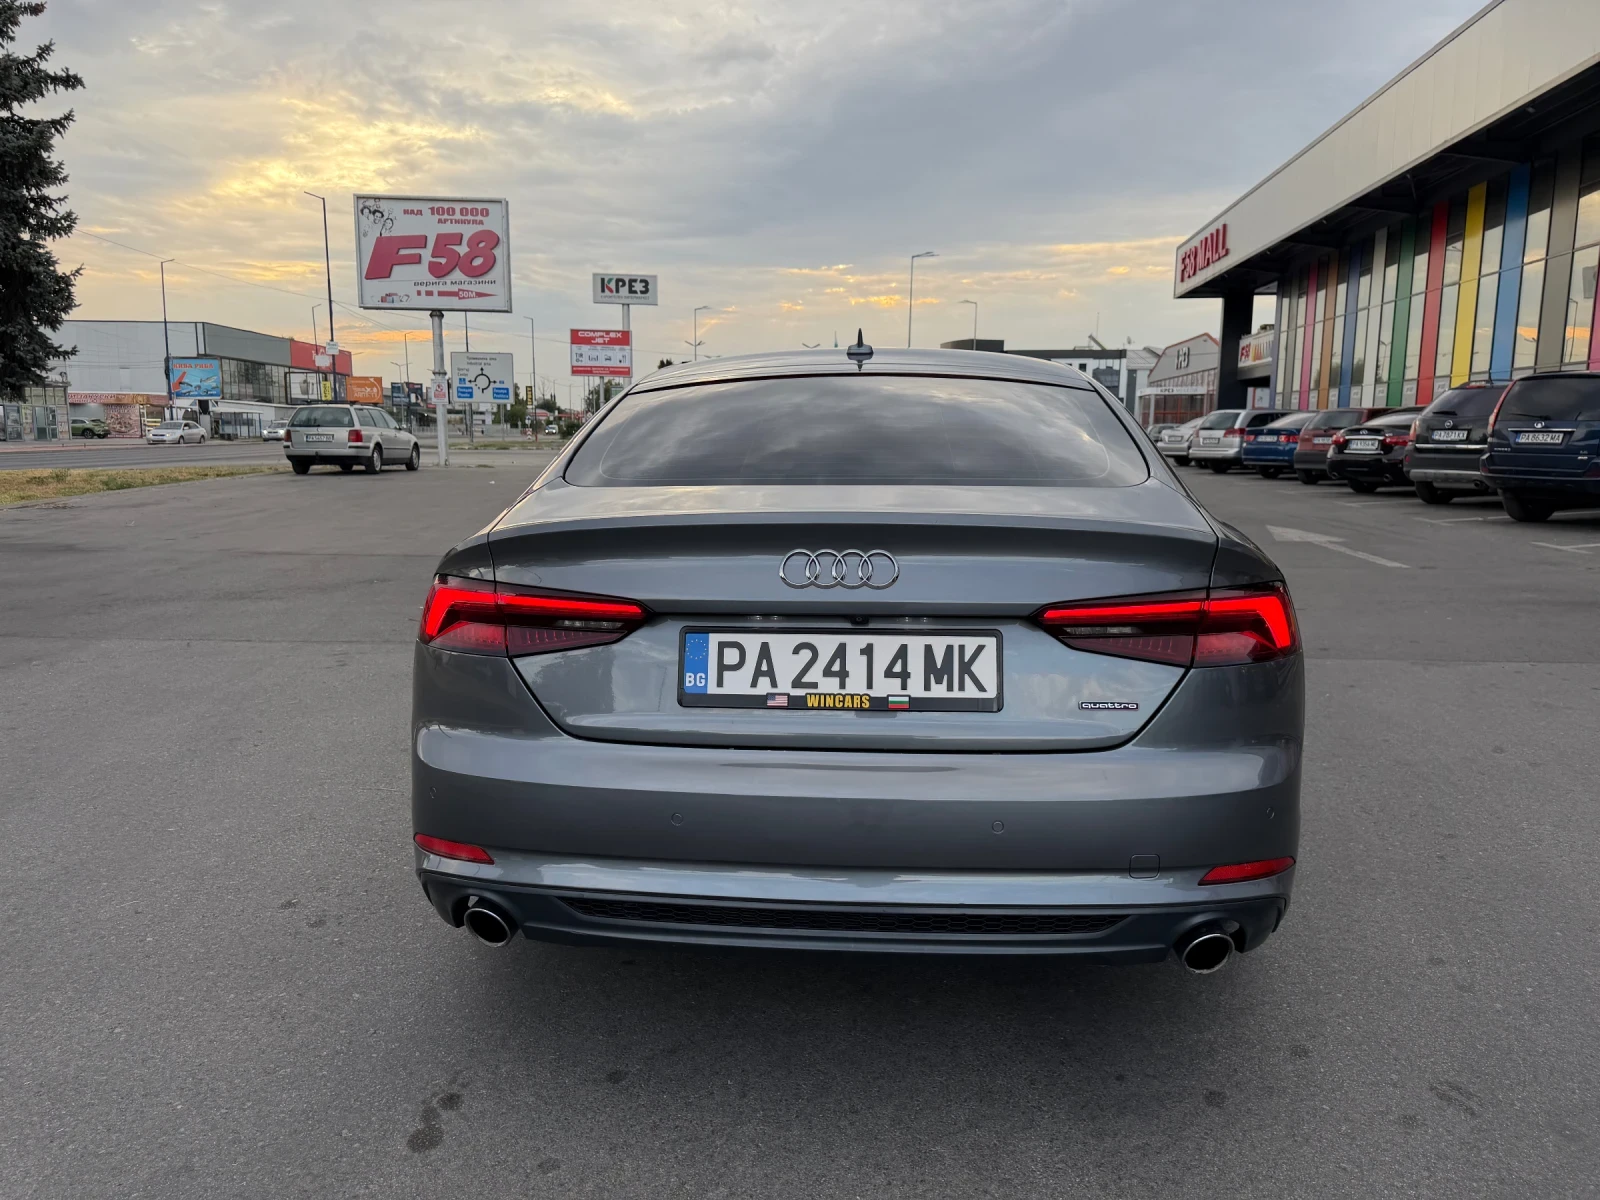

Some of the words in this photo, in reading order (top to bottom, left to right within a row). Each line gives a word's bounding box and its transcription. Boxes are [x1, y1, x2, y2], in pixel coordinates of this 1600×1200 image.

[429, 206, 456, 216] 100
[459, 207, 490, 217] 000
[437, 218, 484, 226] АРТИКУЛА
[1197, 224, 1230, 271] MALL
[600, 277, 649, 294] КРЕЗ
[1520, 433, 1530, 441] PA
[685, 673, 706, 687] BG
[806, 694, 870, 709] WINCARS
